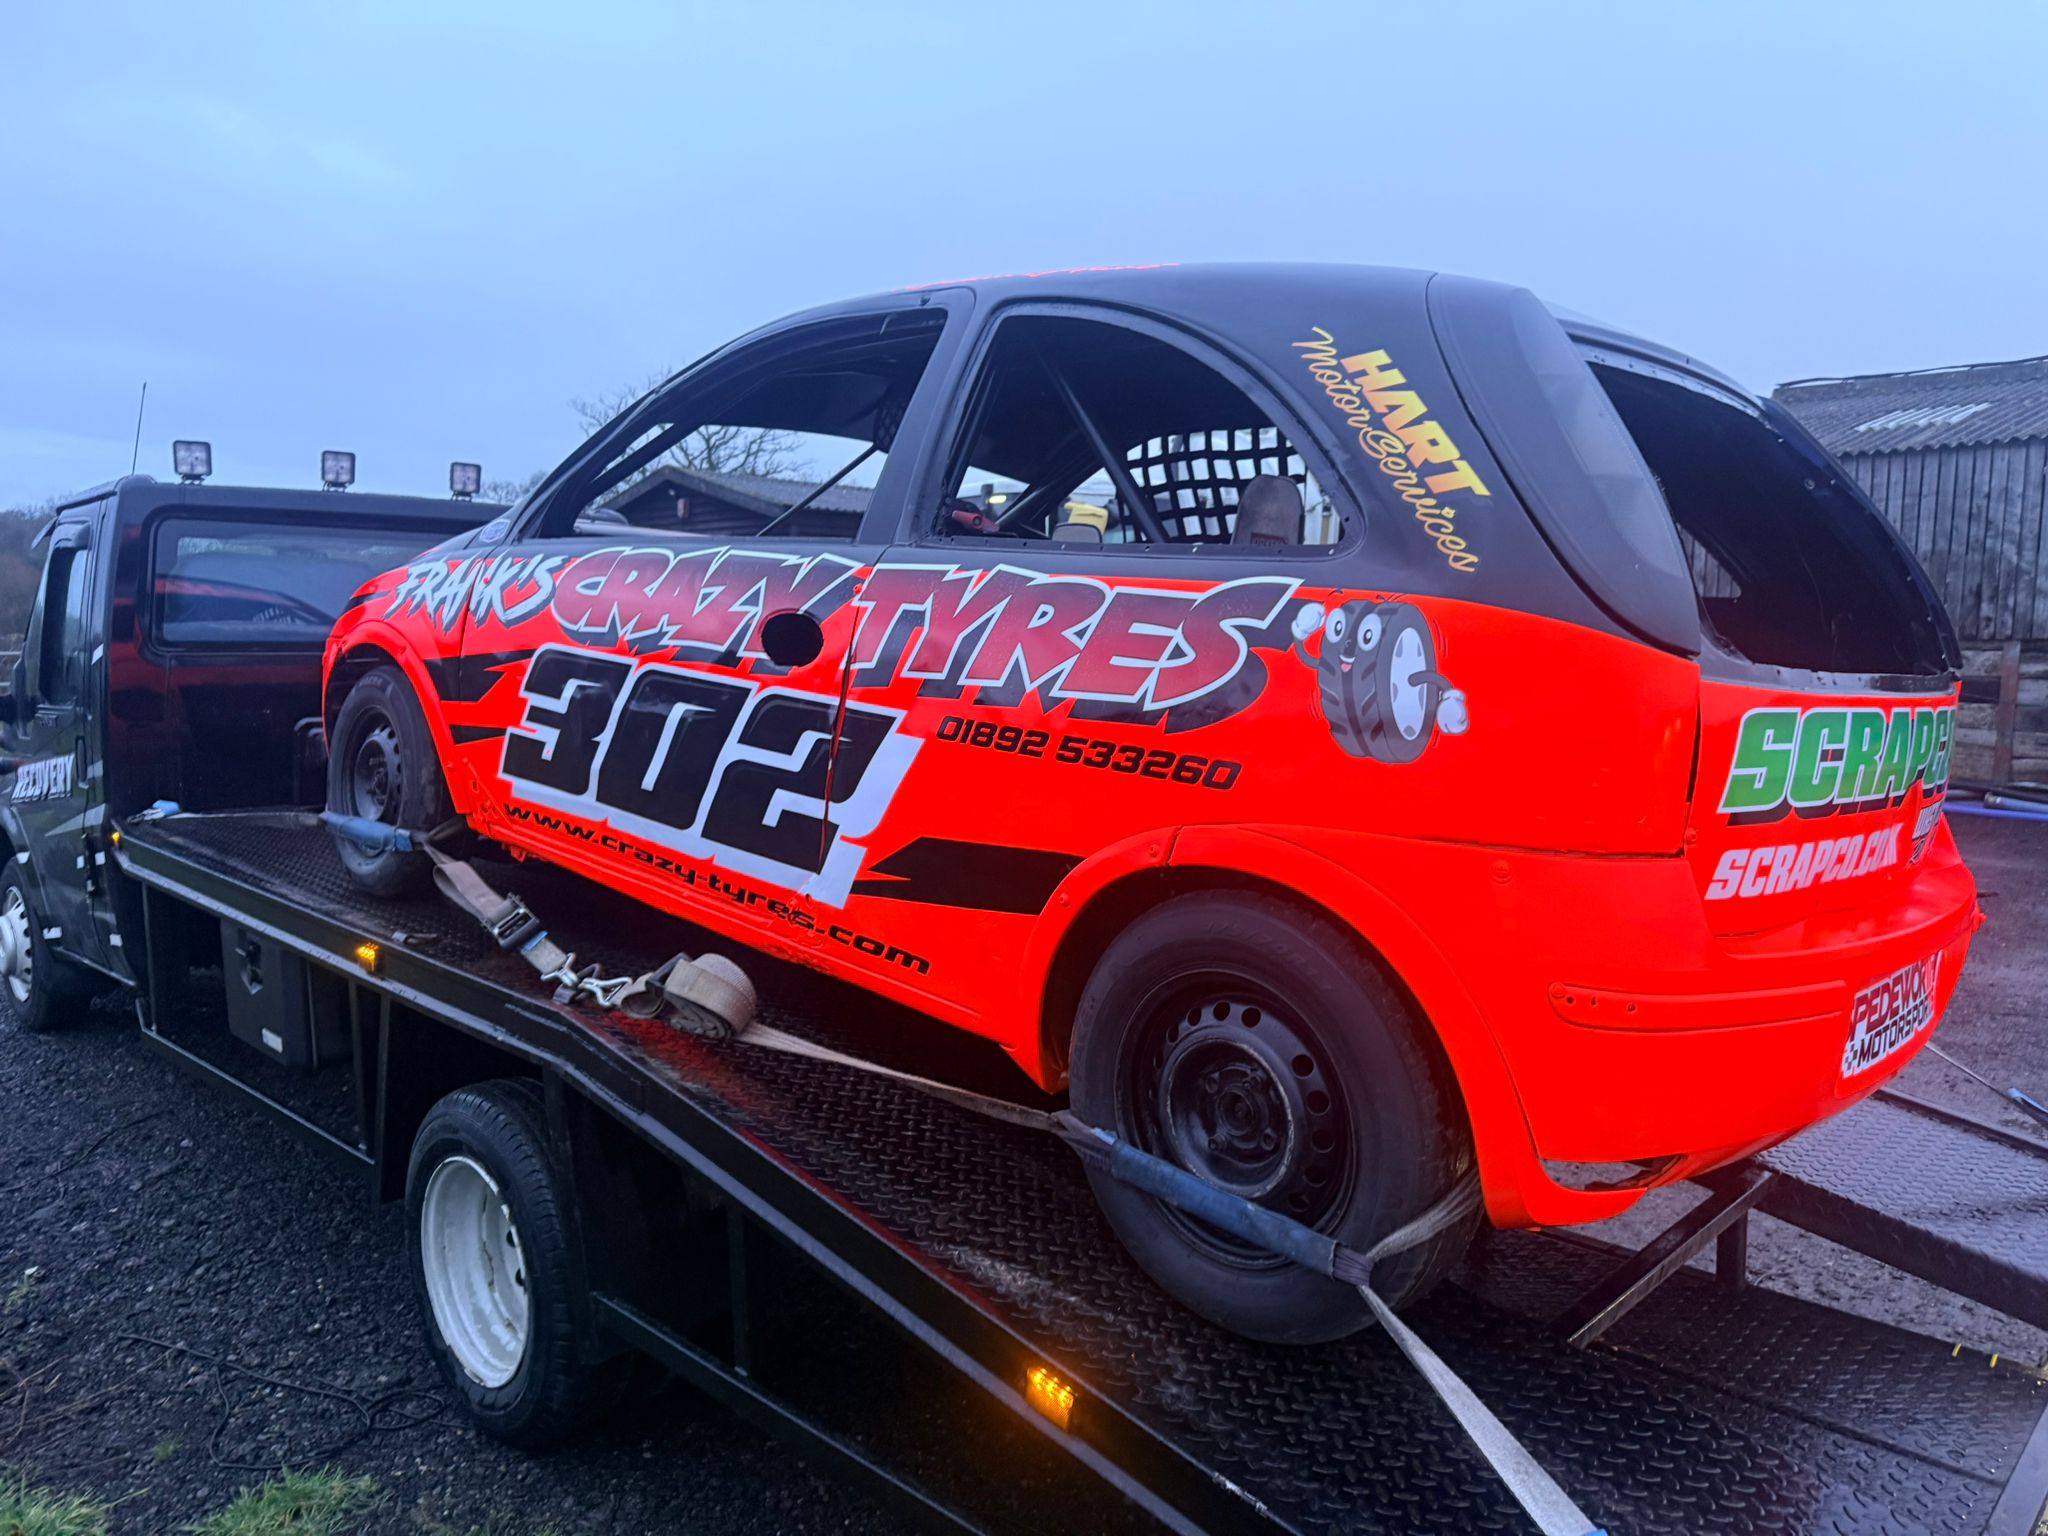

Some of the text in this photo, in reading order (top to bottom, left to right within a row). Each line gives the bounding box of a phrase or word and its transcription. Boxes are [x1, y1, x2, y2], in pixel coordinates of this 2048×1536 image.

[1291, 326, 1480, 573] Motor Services
[1340, 349, 1491, 496] HART
[382, 545, 1304, 711] FRANK'S CRAZY TYRES
[11, 753, 75, 803] RECOVERY
[499, 643, 912, 890] 302
[935, 715, 1243, 792] 01892 533260
[503, 802, 930, 976] www.crazy-tyres.com
[1704, 822, 1904, 901] SCRAPCO.COM
